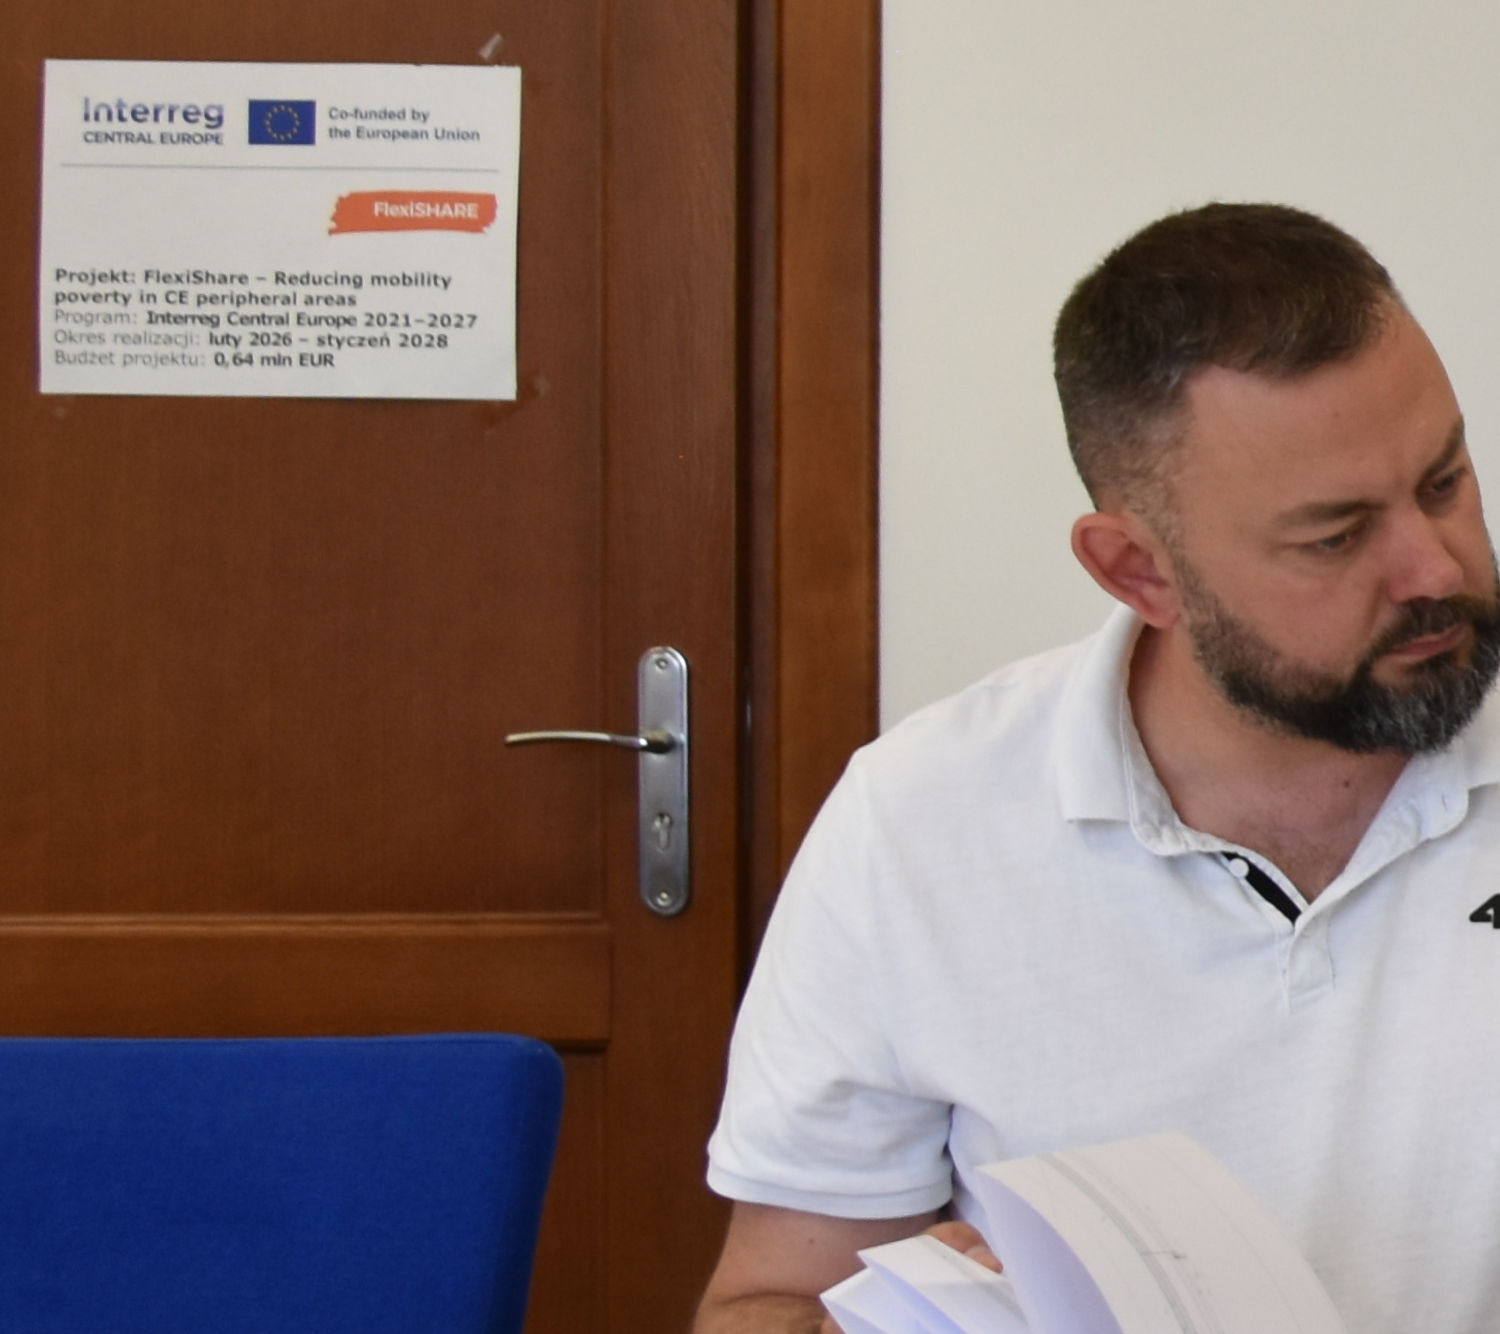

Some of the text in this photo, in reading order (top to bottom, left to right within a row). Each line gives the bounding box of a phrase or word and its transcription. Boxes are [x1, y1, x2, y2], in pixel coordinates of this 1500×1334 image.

[83, 97, 224, 129] Interreg
[328, 107, 430, 123] Co-funded by
[83, 131, 224, 145] CENTRAL EUROPE
[328, 126, 481, 142] the European Union
[373, 201, 479, 219] FlexiSHARE
[55, 268, 136, 291] Projekt:
[144, 269, 249, 285] FlexiShare
[274, 271, 363, 290] Reducing
[370, 271, 452, 290] mobility
[54, 290, 357, 307] poverty in CE peripheral areas
[54, 309, 138, 328] Program:
[147, 311, 221, 328] Interreg
[226, 311, 290, 326] Central
[296, 312, 358, 329] Europe
[54, 329, 106, 344] Okres
[113, 331, 200, 350] realizacji:
[208, 331, 242, 349] luty
[249, 332, 293, 347] 2026
[316, 332, 391, 350] styczeń
[398, 334, 449, 348] 2028
[54, 350, 335, 369] Budżet projektu: 0,64 mln EUR
